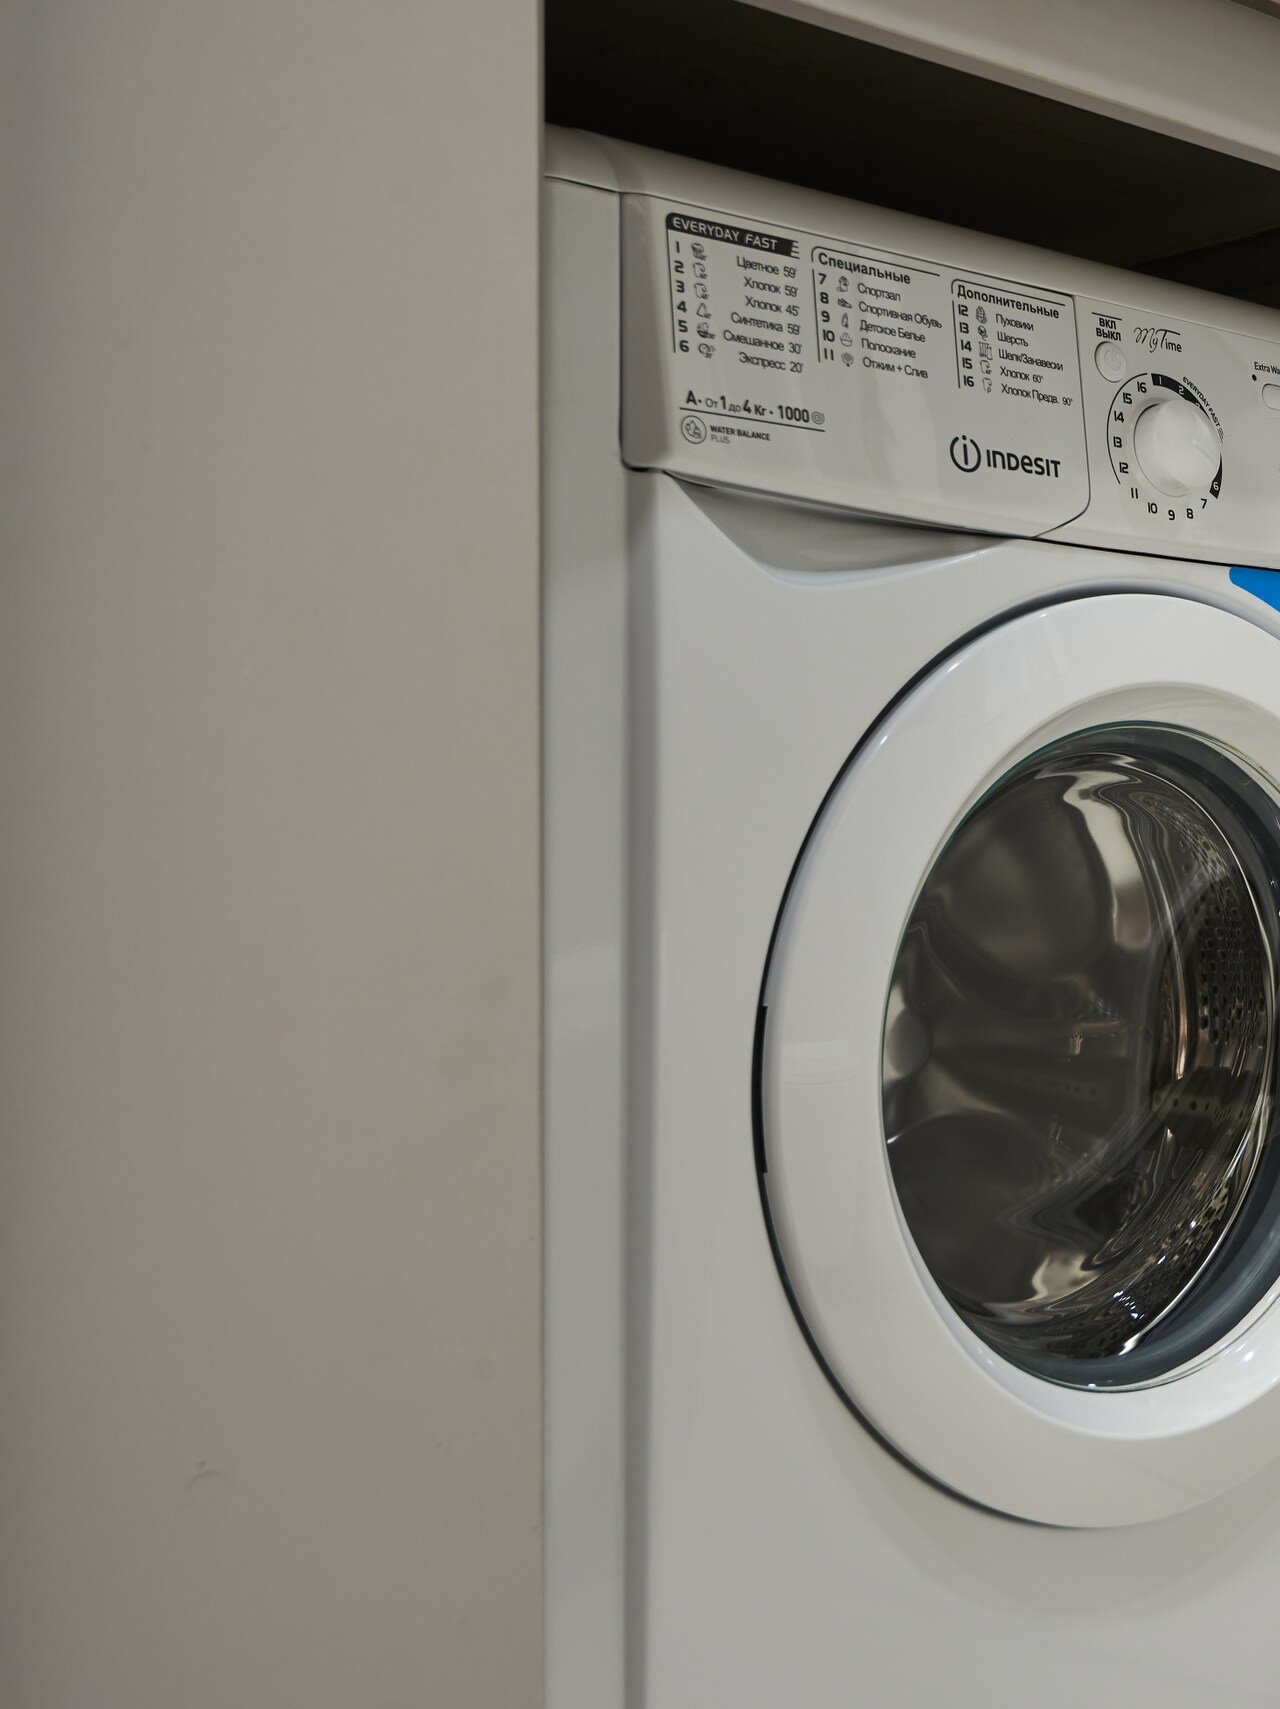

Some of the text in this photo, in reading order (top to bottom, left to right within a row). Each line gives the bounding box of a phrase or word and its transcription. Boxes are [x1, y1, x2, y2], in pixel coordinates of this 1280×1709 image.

[672, 217, 778, 250] EVERYDAY FAST
[675, 241, 681, 253] 1
[736, 256, 780, 275] Цветное
[818, 252, 911, 285] Специальные
[674, 260, 685, 274] 2
[744, 276, 781, 295] Хлопок
[818, 273, 901, 302] 7 Спортзал
[676, 280, 685, 293] 3
[745, 295, 782, 314] Хлопок
[957, 284, 1060, 319] Дополнительные
[676, 300, 688, 313] 4
[731, 312, 783, 333] Синтетика
[820, 292, 943, 329] 8 Спортивная Обувь
[958, 304, 1034, 331] 12 Пуховики
[678, 320, 688, 333] 5
[723, 330, 784, 352] Смешанное
[821, 310, 926, 343] 9 Детское Белье
[959, 322, 1029, 347] 13 Шерсть
[1096, 328, 1121, 342] ВЫКЛ
[1099, 318, 1116, 330] ВКЛ
[679, 340, 690, 352] 6
[739, 352, 786, 371] Экспресс
[823, 329, 916, 360] 10 Полоскание
[960, 340, 1064, 371] 14 Шелк/Занавески
[824, 348, 834, 361] 11
[863, 357, 895, 373] Отжим
[904, 364, 929, 379] Слив
[962, 357, 973, 369] 15
[1000, 365, 1030, 381] Хлопок
[1254, 362, 1270, 373] Extra
[963, 375, 974, 387] 16
[1001, 383, 1031, 398] Хлопок
[1032, 389, 1059, 404] Предв.
[1122, 392, 1132, 404] 15
[1136, 381, 1147, 393] 16
[1178, 385, 1184, 395] 2
[706, 398, 718, 408] От
[720, 395, 726, 410] 1
[729, 404, 741, 413] до
[743, 399, 751, 414] 4
[755, 404, 767, 416] Кг
[778, 405, 810, 423] 1000
[1183, 376, 1221, 427] EVERYDAY FAST
[1114, 411, 1124, 423] 14
[710, 425, 771, 441] WATER BALANCE
[711, 434, 730, 444] PLUS
[1113, 436, 1122, 448] 13
[1119, 462, 1129, 474] 12
[1131, 488, 1139, 499] 11
[1212, 481, 1219, 491] 6
[1147, 502, 1158, 514] 10
[1168, 509, 1175, 520] 9
[1186, 508, 1193, 519] 8
[1200, 498, 1207, 509] 7
